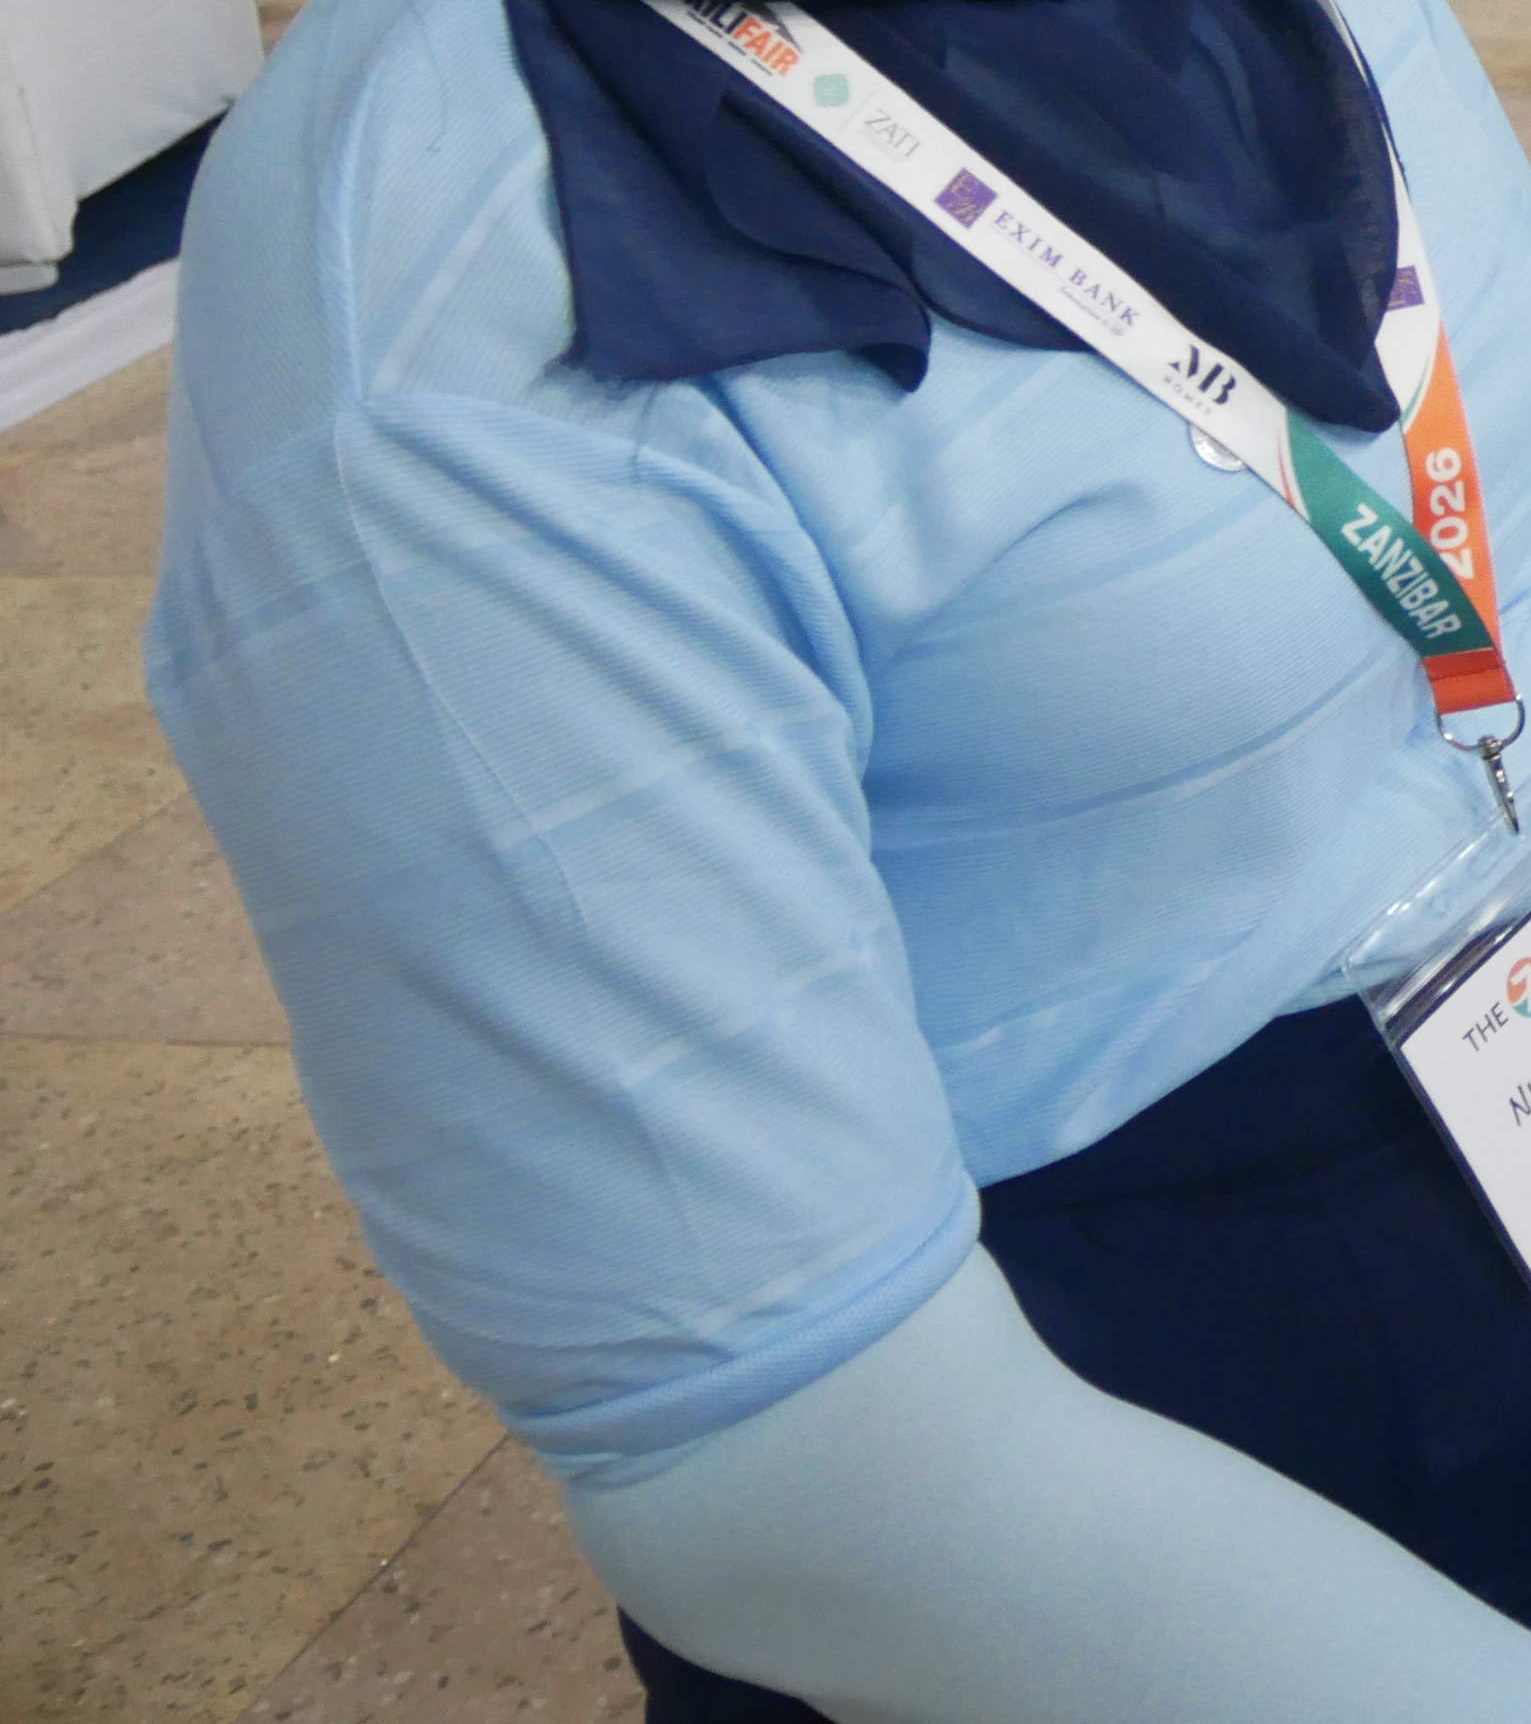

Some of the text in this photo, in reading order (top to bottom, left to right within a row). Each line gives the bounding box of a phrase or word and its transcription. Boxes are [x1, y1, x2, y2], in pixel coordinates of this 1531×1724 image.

[865, 108, 922, 158] ZATI
[991, 208, 1141, 328] EXIM BANK
[1162, 375, 1213, 417] HOMES
[1427, 447, 1474, 581] 2026
[1340, 503, 1462, 642] ZANZIBAR
[1462, 1002, 1509, 1053] THE
